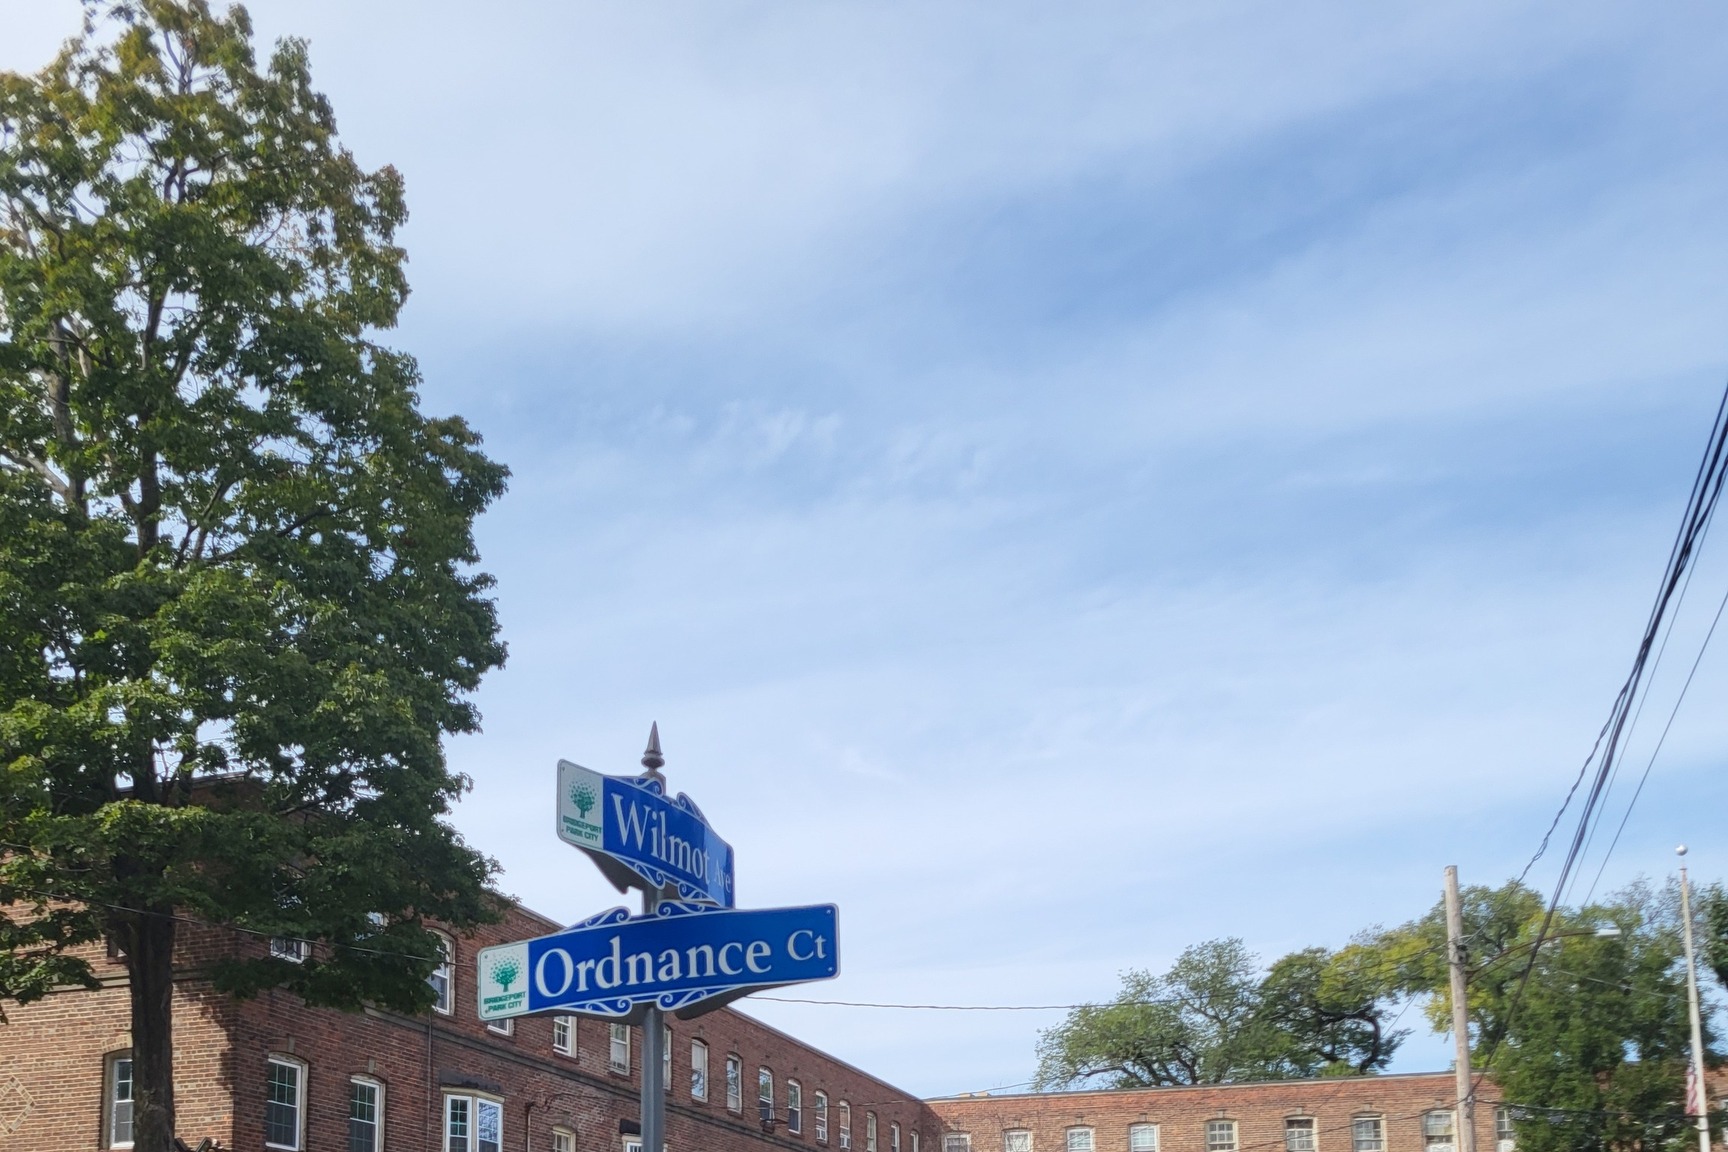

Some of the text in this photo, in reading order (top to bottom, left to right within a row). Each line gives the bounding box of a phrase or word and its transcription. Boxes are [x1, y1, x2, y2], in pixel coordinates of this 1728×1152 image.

[563, 815, 601, 834] BRIDGEPORT
[566, 825, 598, 841] PARK CITY
[611, 793, 710, 885] Wilmot
[535, 929, 827, 998] Ordnance Ct
[484, 991, 526, 1004] BRIDGEPORT
[488, 1000, 522, 1011] PARK CITY
